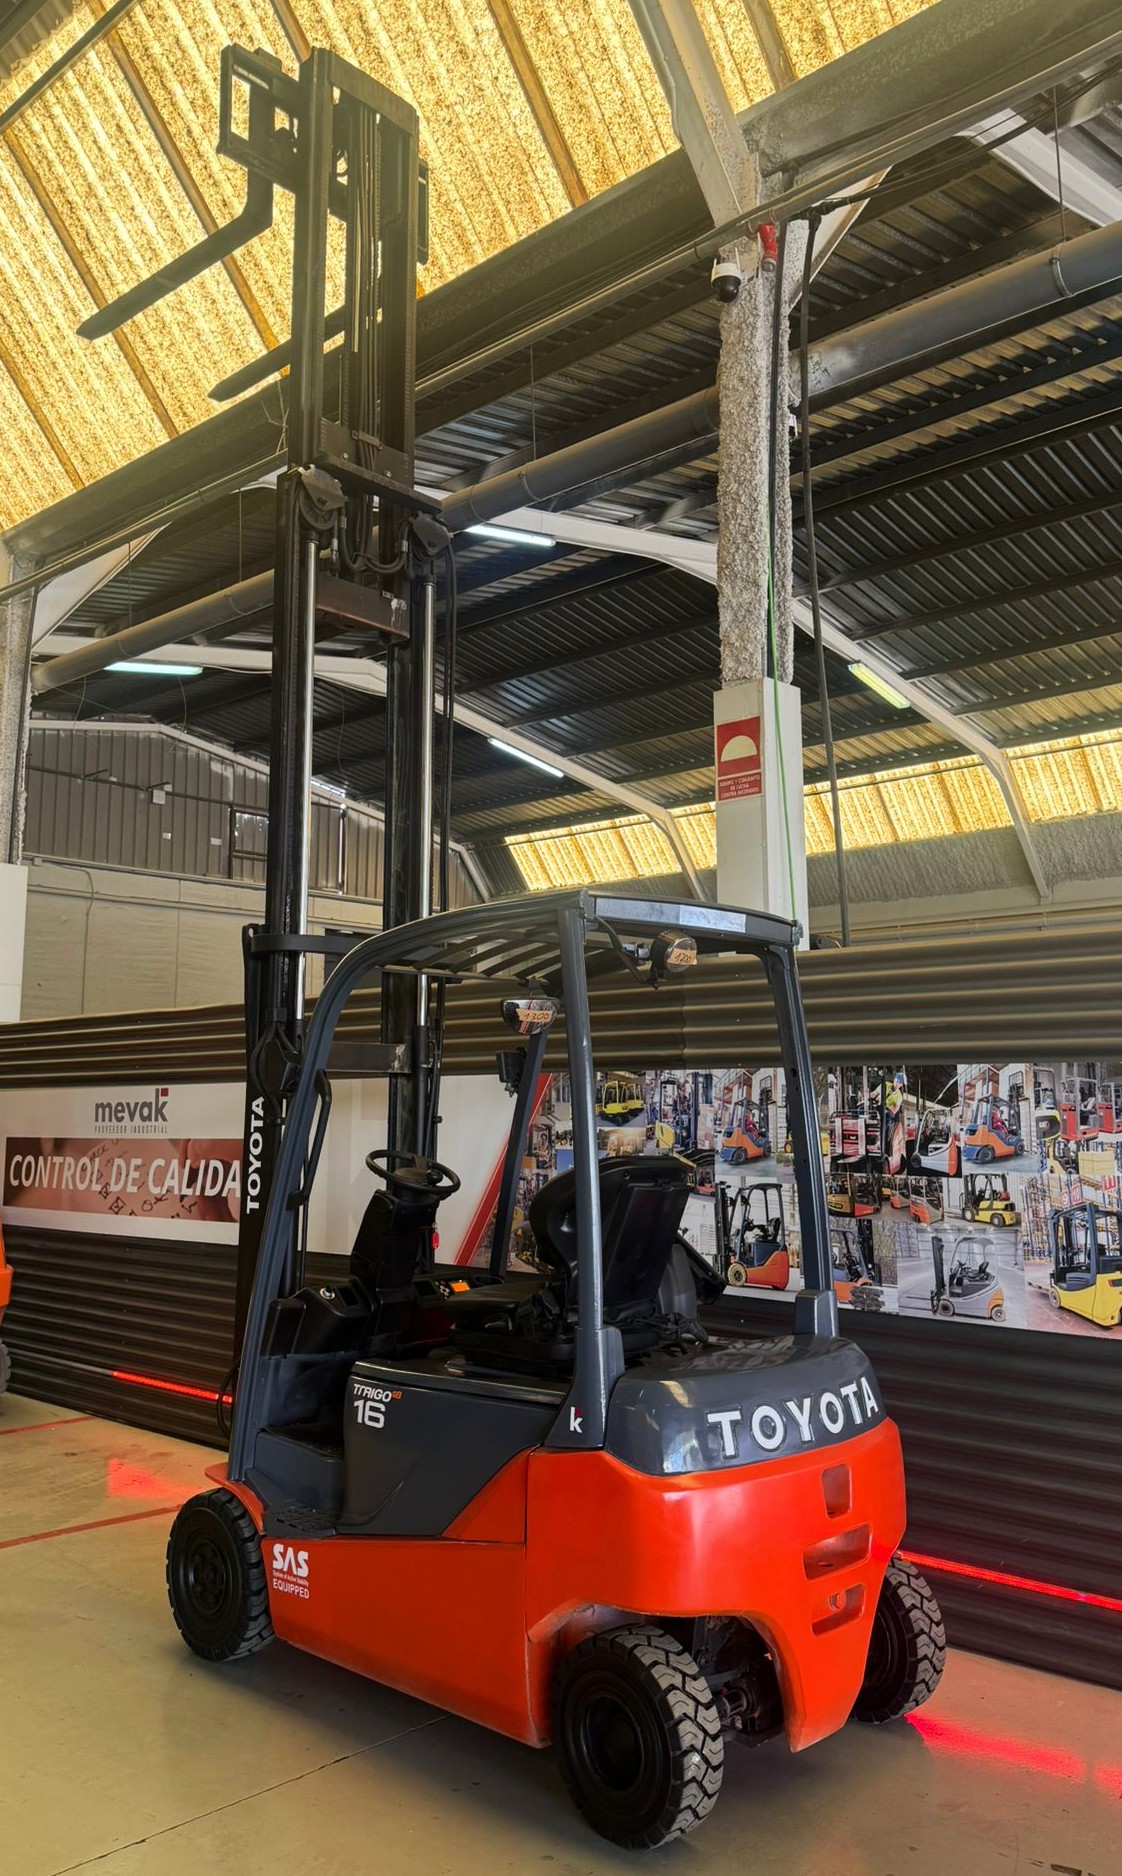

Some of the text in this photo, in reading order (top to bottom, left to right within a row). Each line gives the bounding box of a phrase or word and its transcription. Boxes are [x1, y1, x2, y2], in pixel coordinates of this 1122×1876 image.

[94, 1088, 168, 1123] mevak
[130, 1125, 168, 1134] INDUSTRIAL
[246, 1096, 265, 1214] TOYOTA
[9, 1154, 101, 1192] CONTROL
[110, 1157, 143, 1194] DE
[148, 1158, 241, 1198] CALIDA
[353, 1399, 386, 1429] 16
[706, 1376, 879, 1457] TOYOTA
[272, 1543, 309, 1578] SAS
[272, 1578, 310, 1599] EQUIPPED
